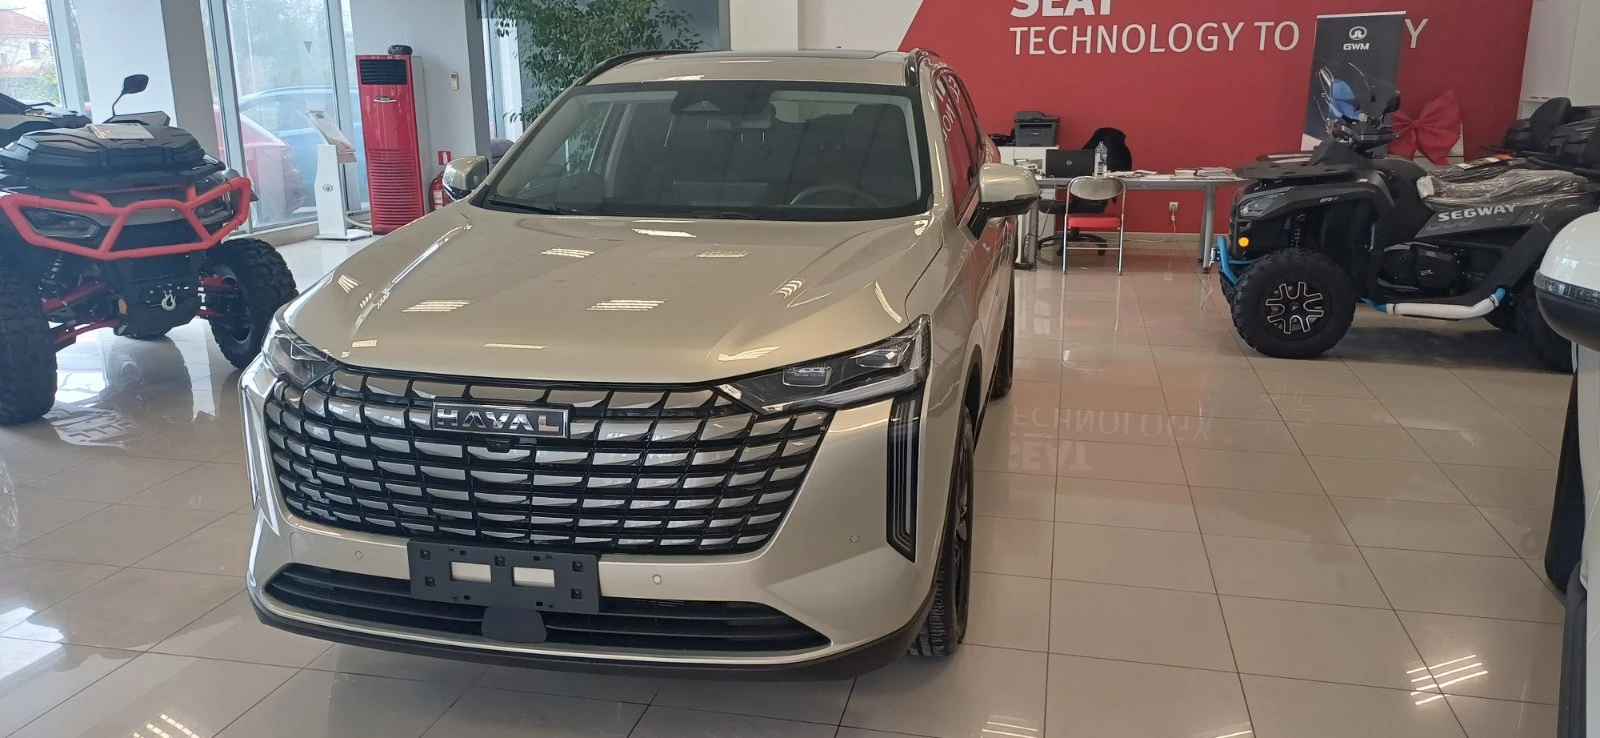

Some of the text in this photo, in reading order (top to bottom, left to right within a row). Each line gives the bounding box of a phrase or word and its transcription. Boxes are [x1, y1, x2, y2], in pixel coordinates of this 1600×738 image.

[1009, 20, 1300, 55] TECHNOLOGY TO
[1342, 42, 1370, 51] GWM
[1437, 203, 1517, 222] SEGWAY
[437, 408, 560, 433] HAVAL
